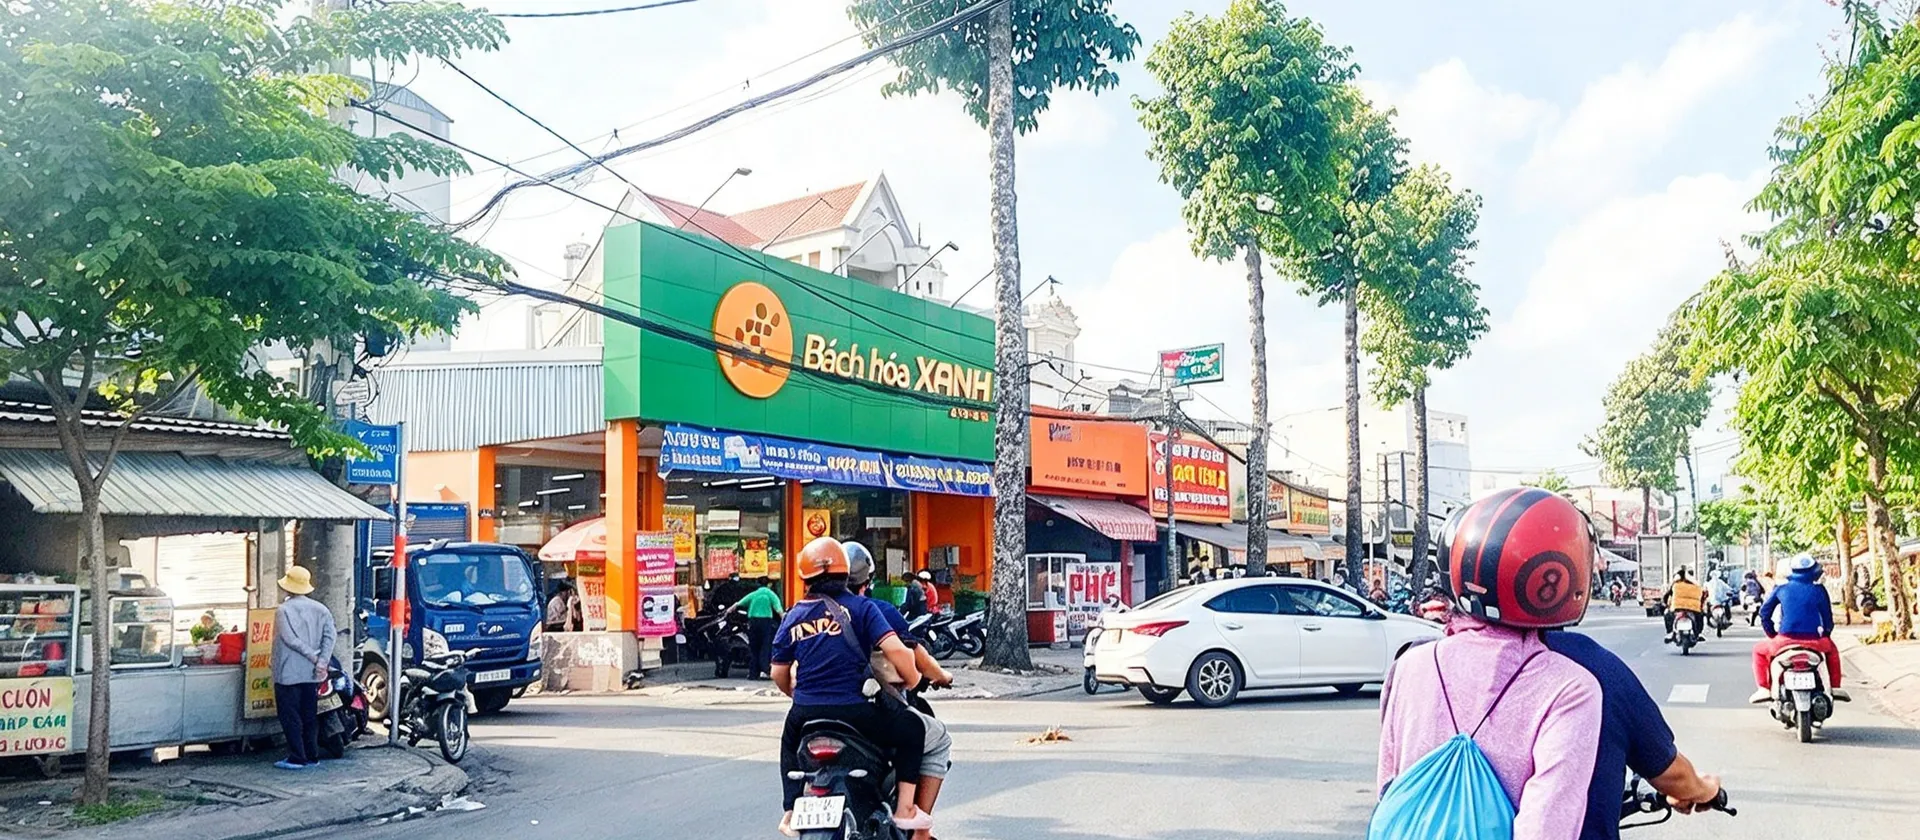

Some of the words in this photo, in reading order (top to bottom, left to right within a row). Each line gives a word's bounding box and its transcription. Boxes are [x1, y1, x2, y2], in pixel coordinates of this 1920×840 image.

[803, 333, 866, 379] Bách
[869, 347, 911, 389] hóa
[914, 356, 993, 403] XANH
[1537, 568, 1562, 602] 8
